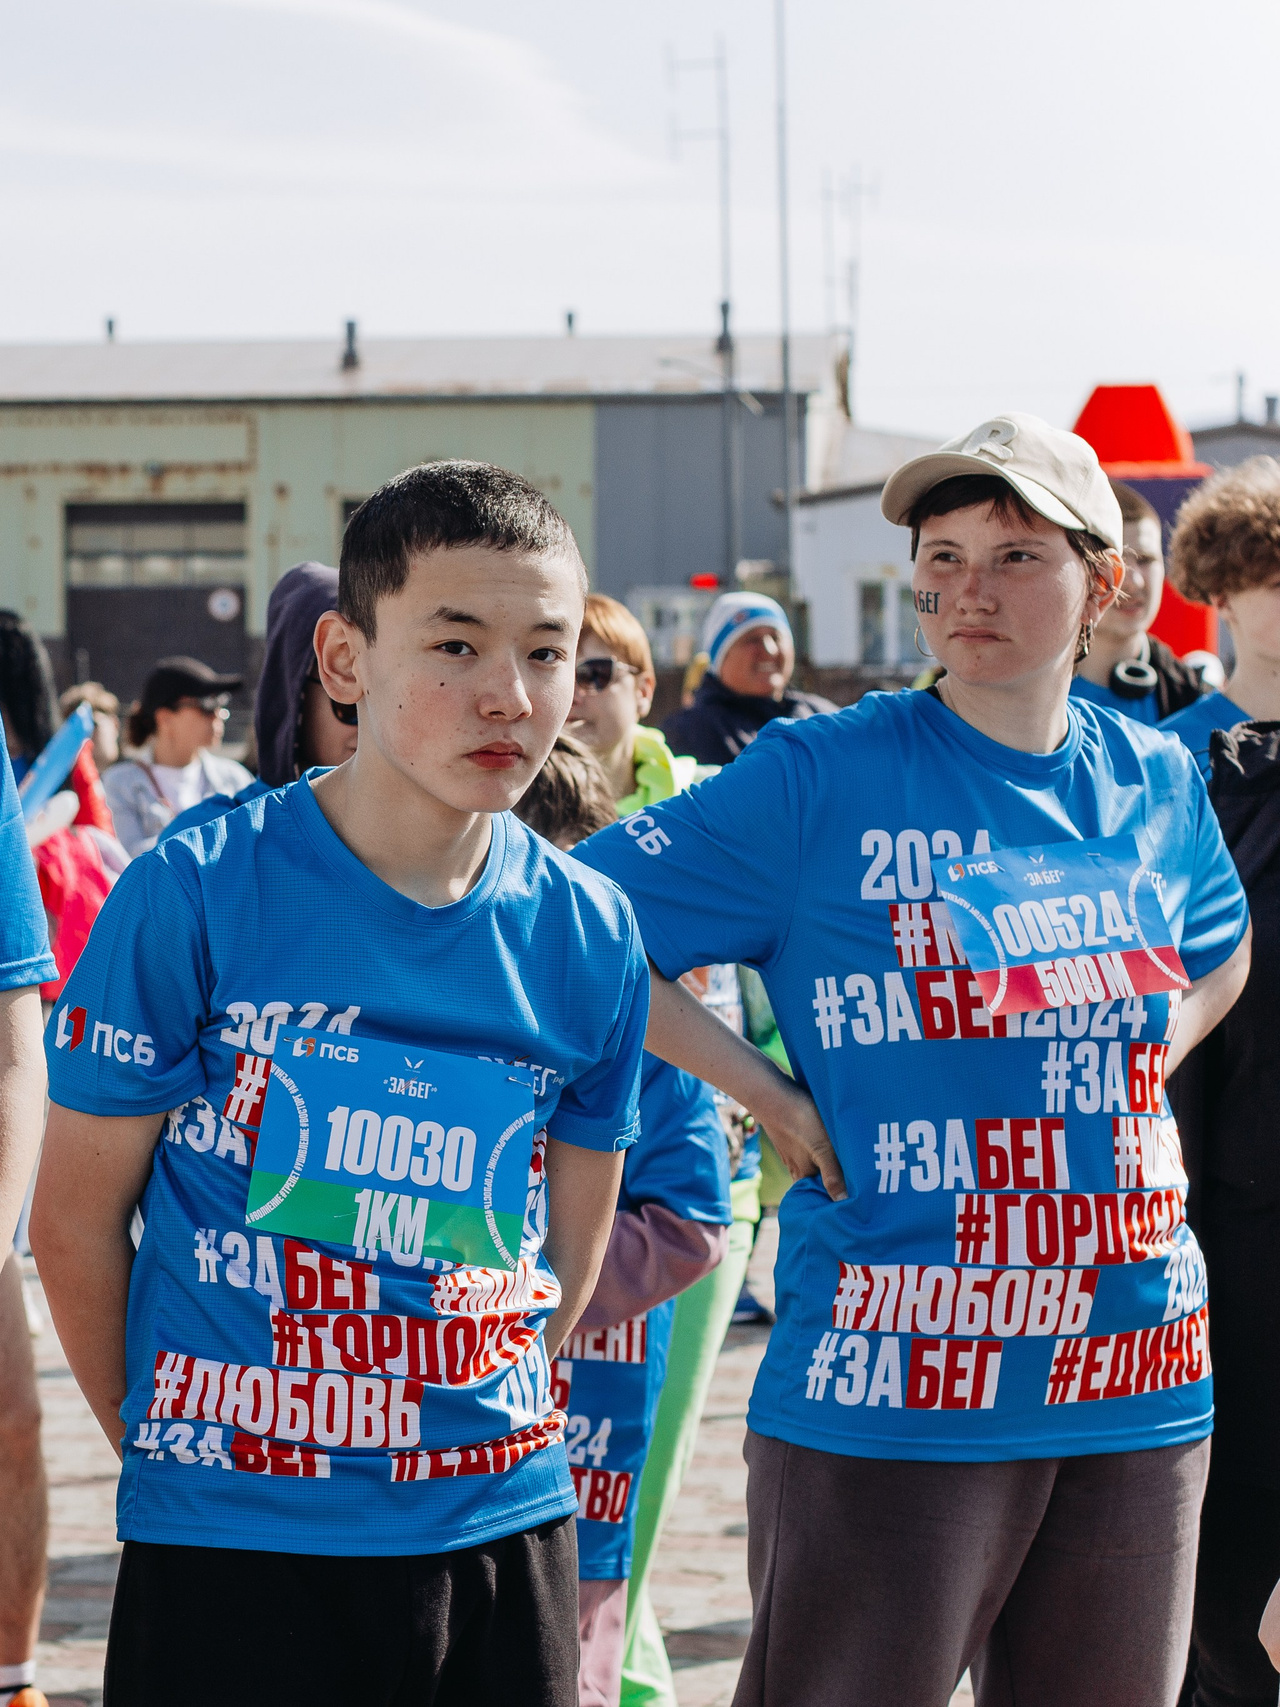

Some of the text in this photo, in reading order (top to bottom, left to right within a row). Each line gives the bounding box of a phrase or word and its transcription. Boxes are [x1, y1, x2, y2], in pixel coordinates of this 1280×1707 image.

[967, 861, 999, 876] ПСБ
[992, 890, 1136, 958] 00524
[91, 1020, 156, 1068] ПСБ
[320, 1043, 360, 1064] ПСБ
[324, 1105, 478, 1192] 10030
[874, 1117, 1066, 1193] #ЗАБЕГ
[194, 1227, 376, 1310] #ЗАБЕГ
[833, 1263, 1096, 1337] #ЛЮБОВЬ
[150, 1351, 423, 1449] #ЛЮБОВЬ
[806, 1332, 1004, 1409] #ЗАБЕГ
